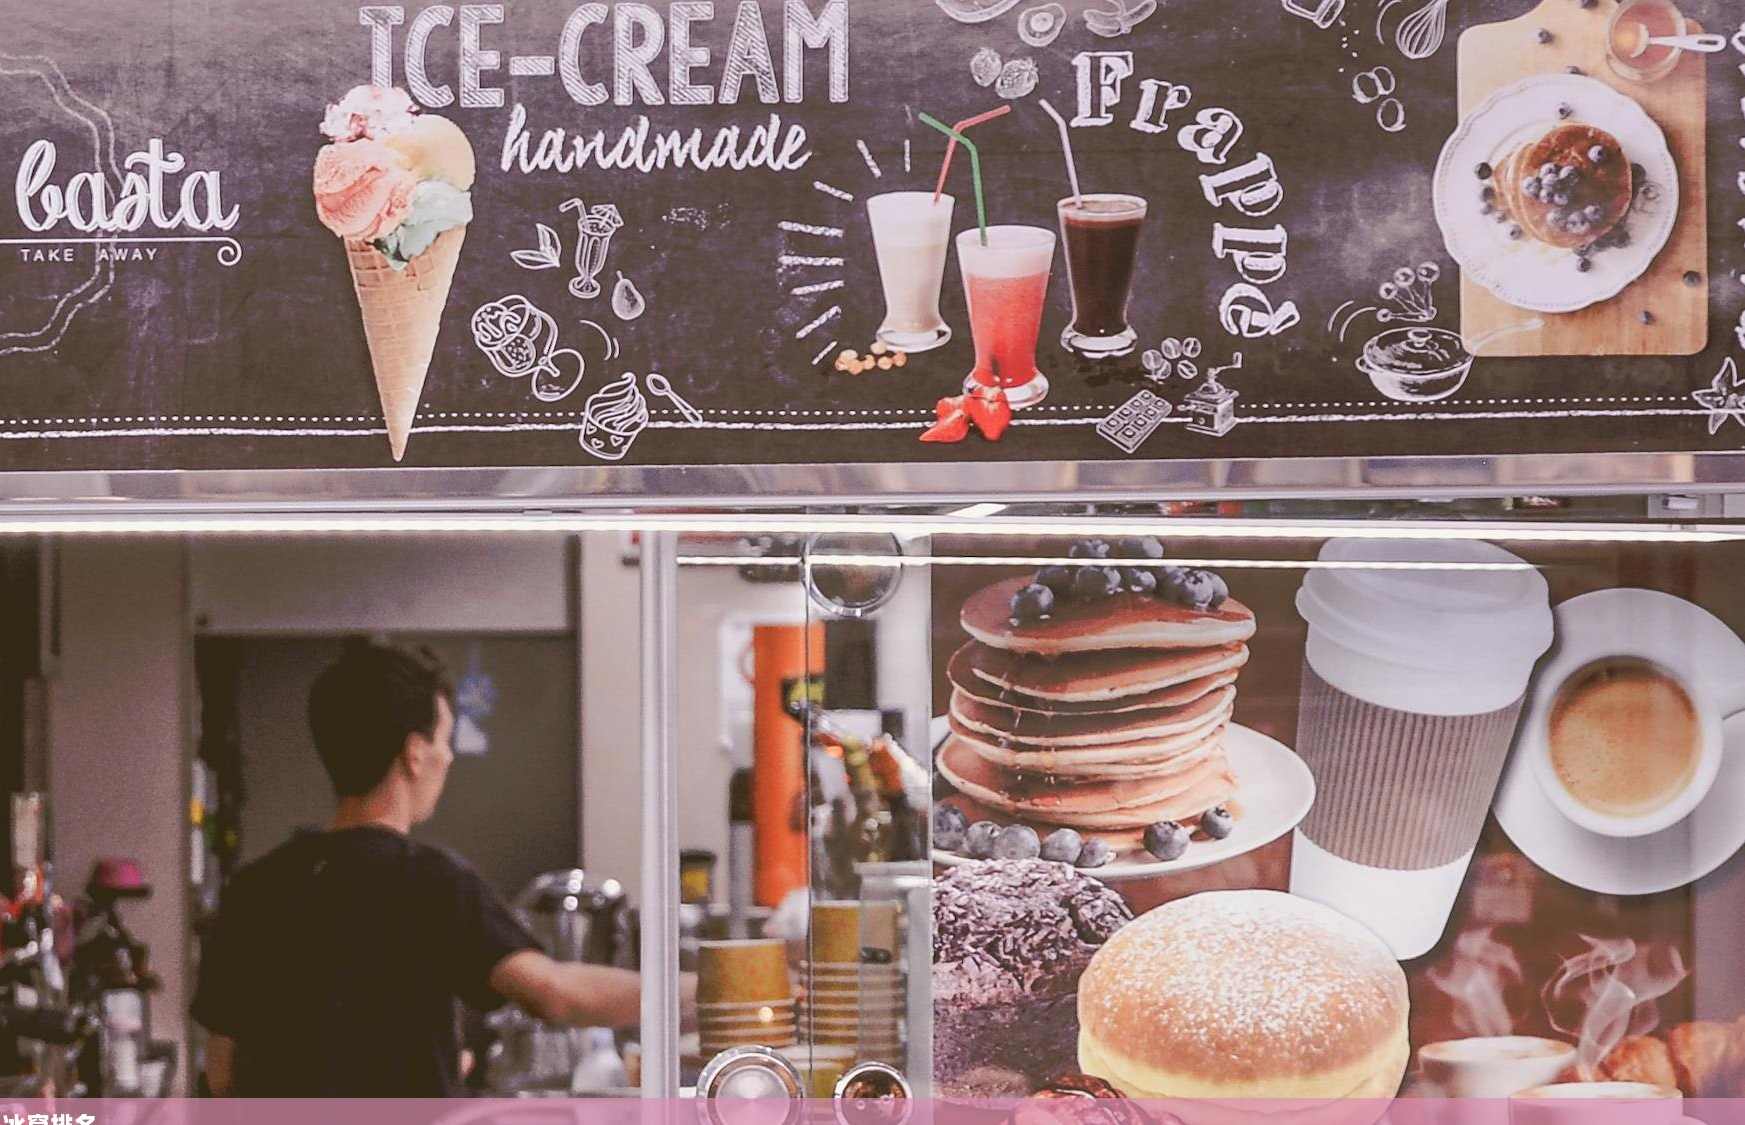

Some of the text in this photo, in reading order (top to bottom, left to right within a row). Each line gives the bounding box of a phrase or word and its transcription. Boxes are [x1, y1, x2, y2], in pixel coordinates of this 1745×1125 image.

[359, 0, 851, 107] ICE-CREAM
[500, 104, 812, 174] handmade
[15, 137, 241, 234] basta
[21, 248, 74, 263] TAKE
[97, 247, 158, 262] AWAY
